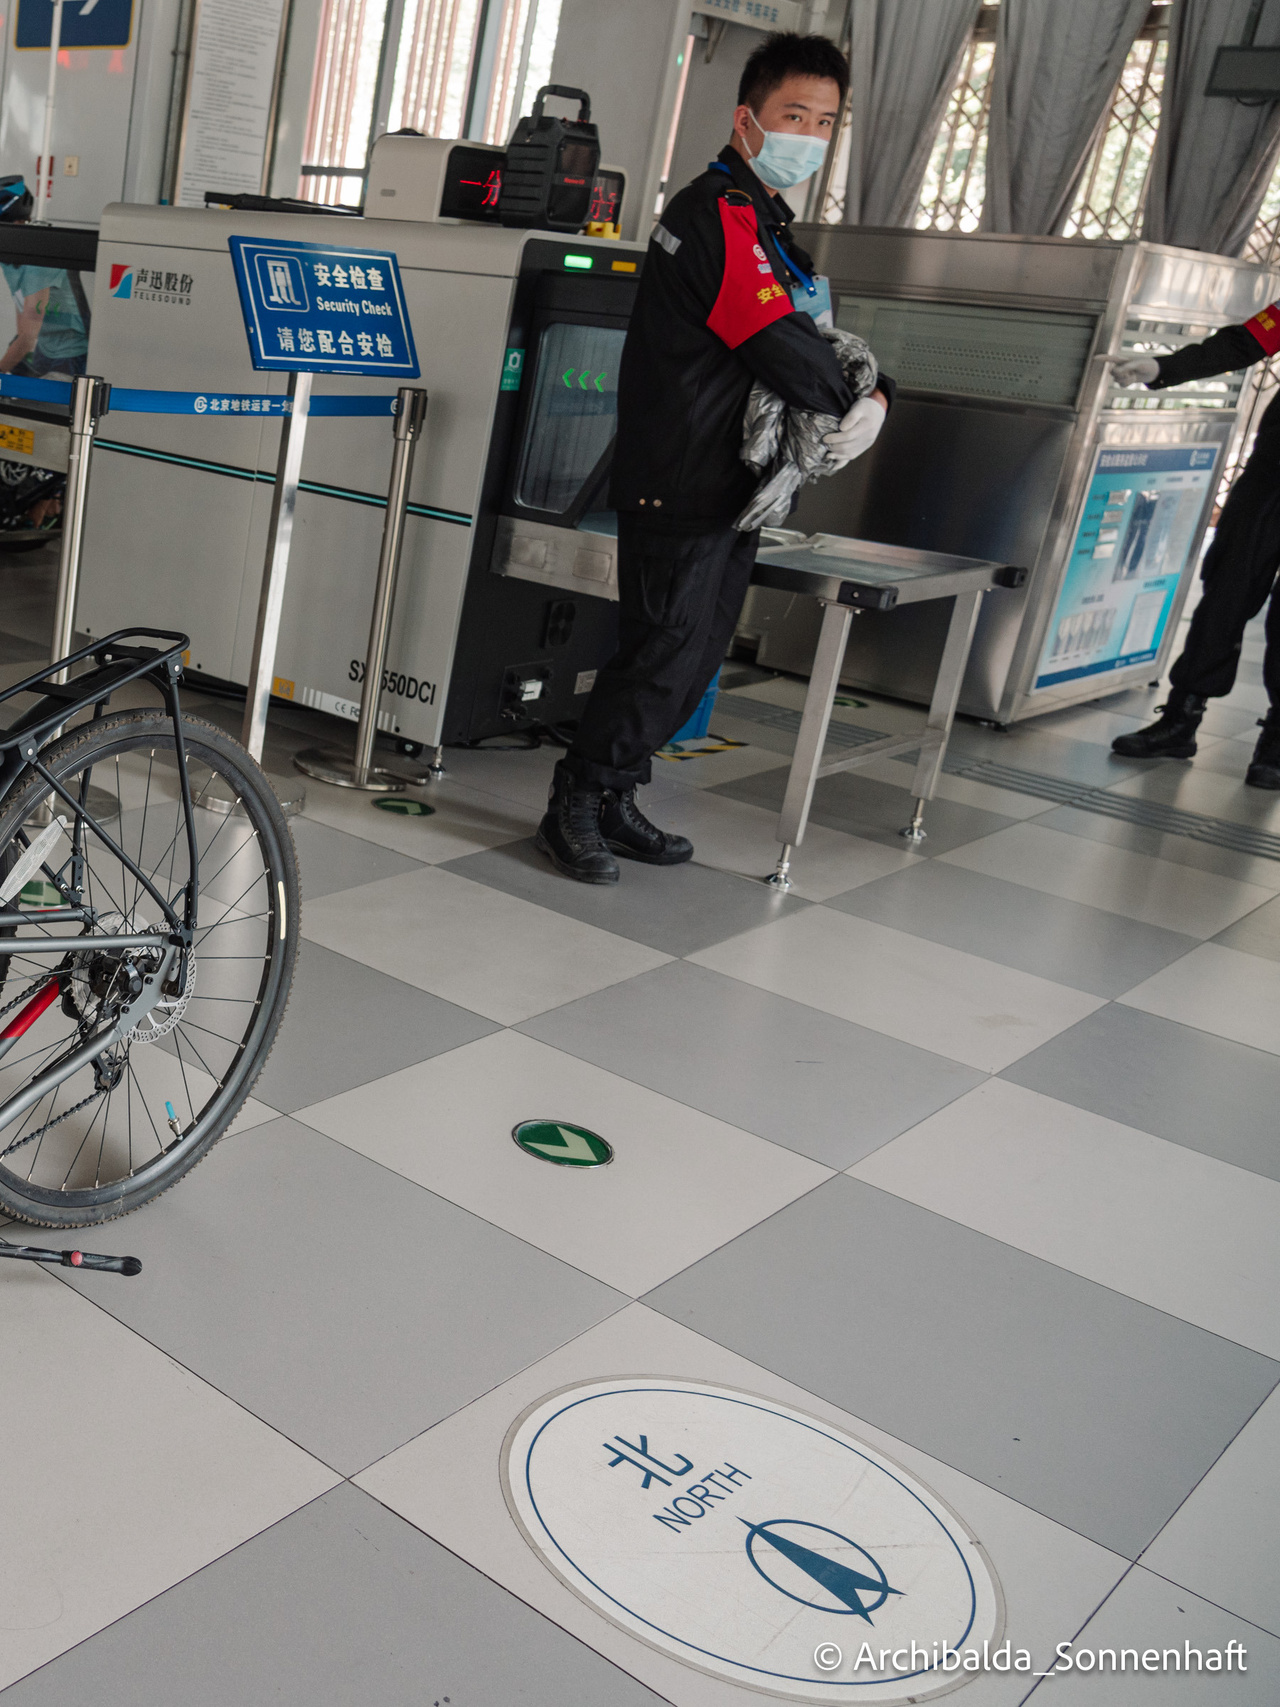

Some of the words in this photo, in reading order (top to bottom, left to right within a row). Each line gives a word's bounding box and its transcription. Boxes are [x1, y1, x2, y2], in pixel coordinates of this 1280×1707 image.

[135, 267, 194, 294] 声迅股份
[313, 262, 386, 292] 安全检查
[133, 290, 192, 306] TELESOUND
[316, 296, 360, 317] Security
[361, 299, 394, 317] Check
[276, 327, 395, 358] 请您配合安检
[601, 1433, 695, 1490] 北
[651, 1461, 754, 1535] NORTH
